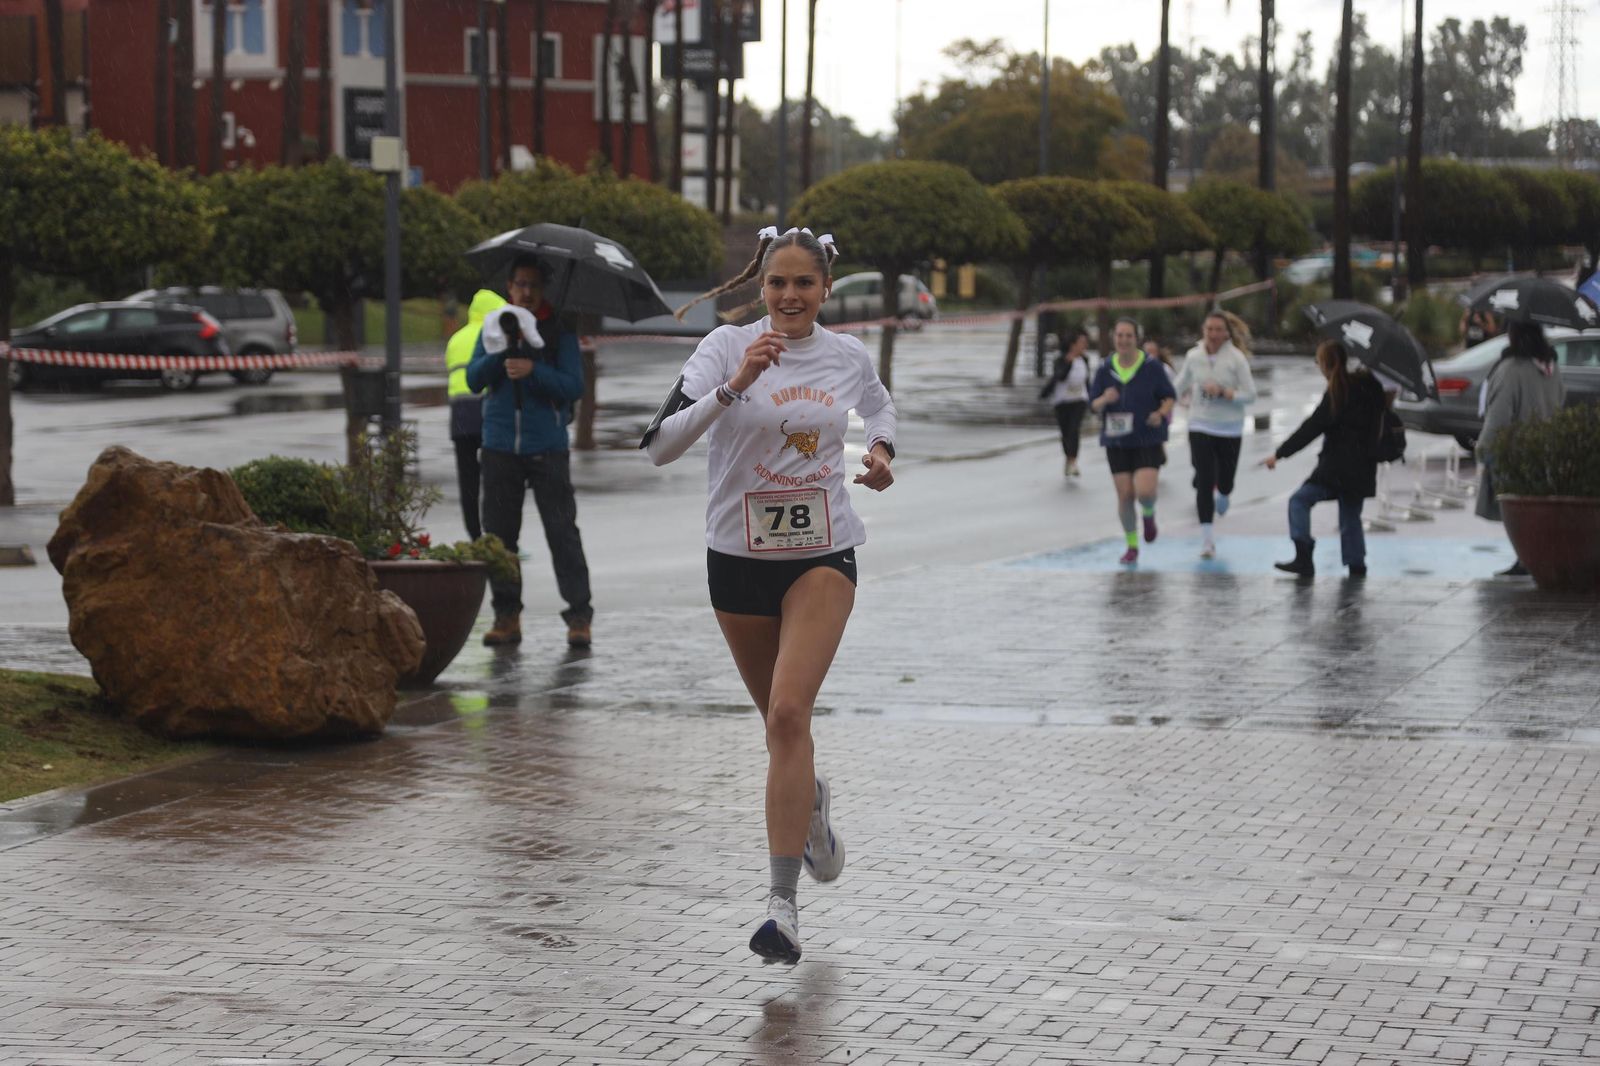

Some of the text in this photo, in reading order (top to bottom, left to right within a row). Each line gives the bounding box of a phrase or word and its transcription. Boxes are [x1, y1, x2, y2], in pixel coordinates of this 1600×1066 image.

[753, 463, 832, 486] RUNNING CLUB
[765, 504, 811, 531] 78
